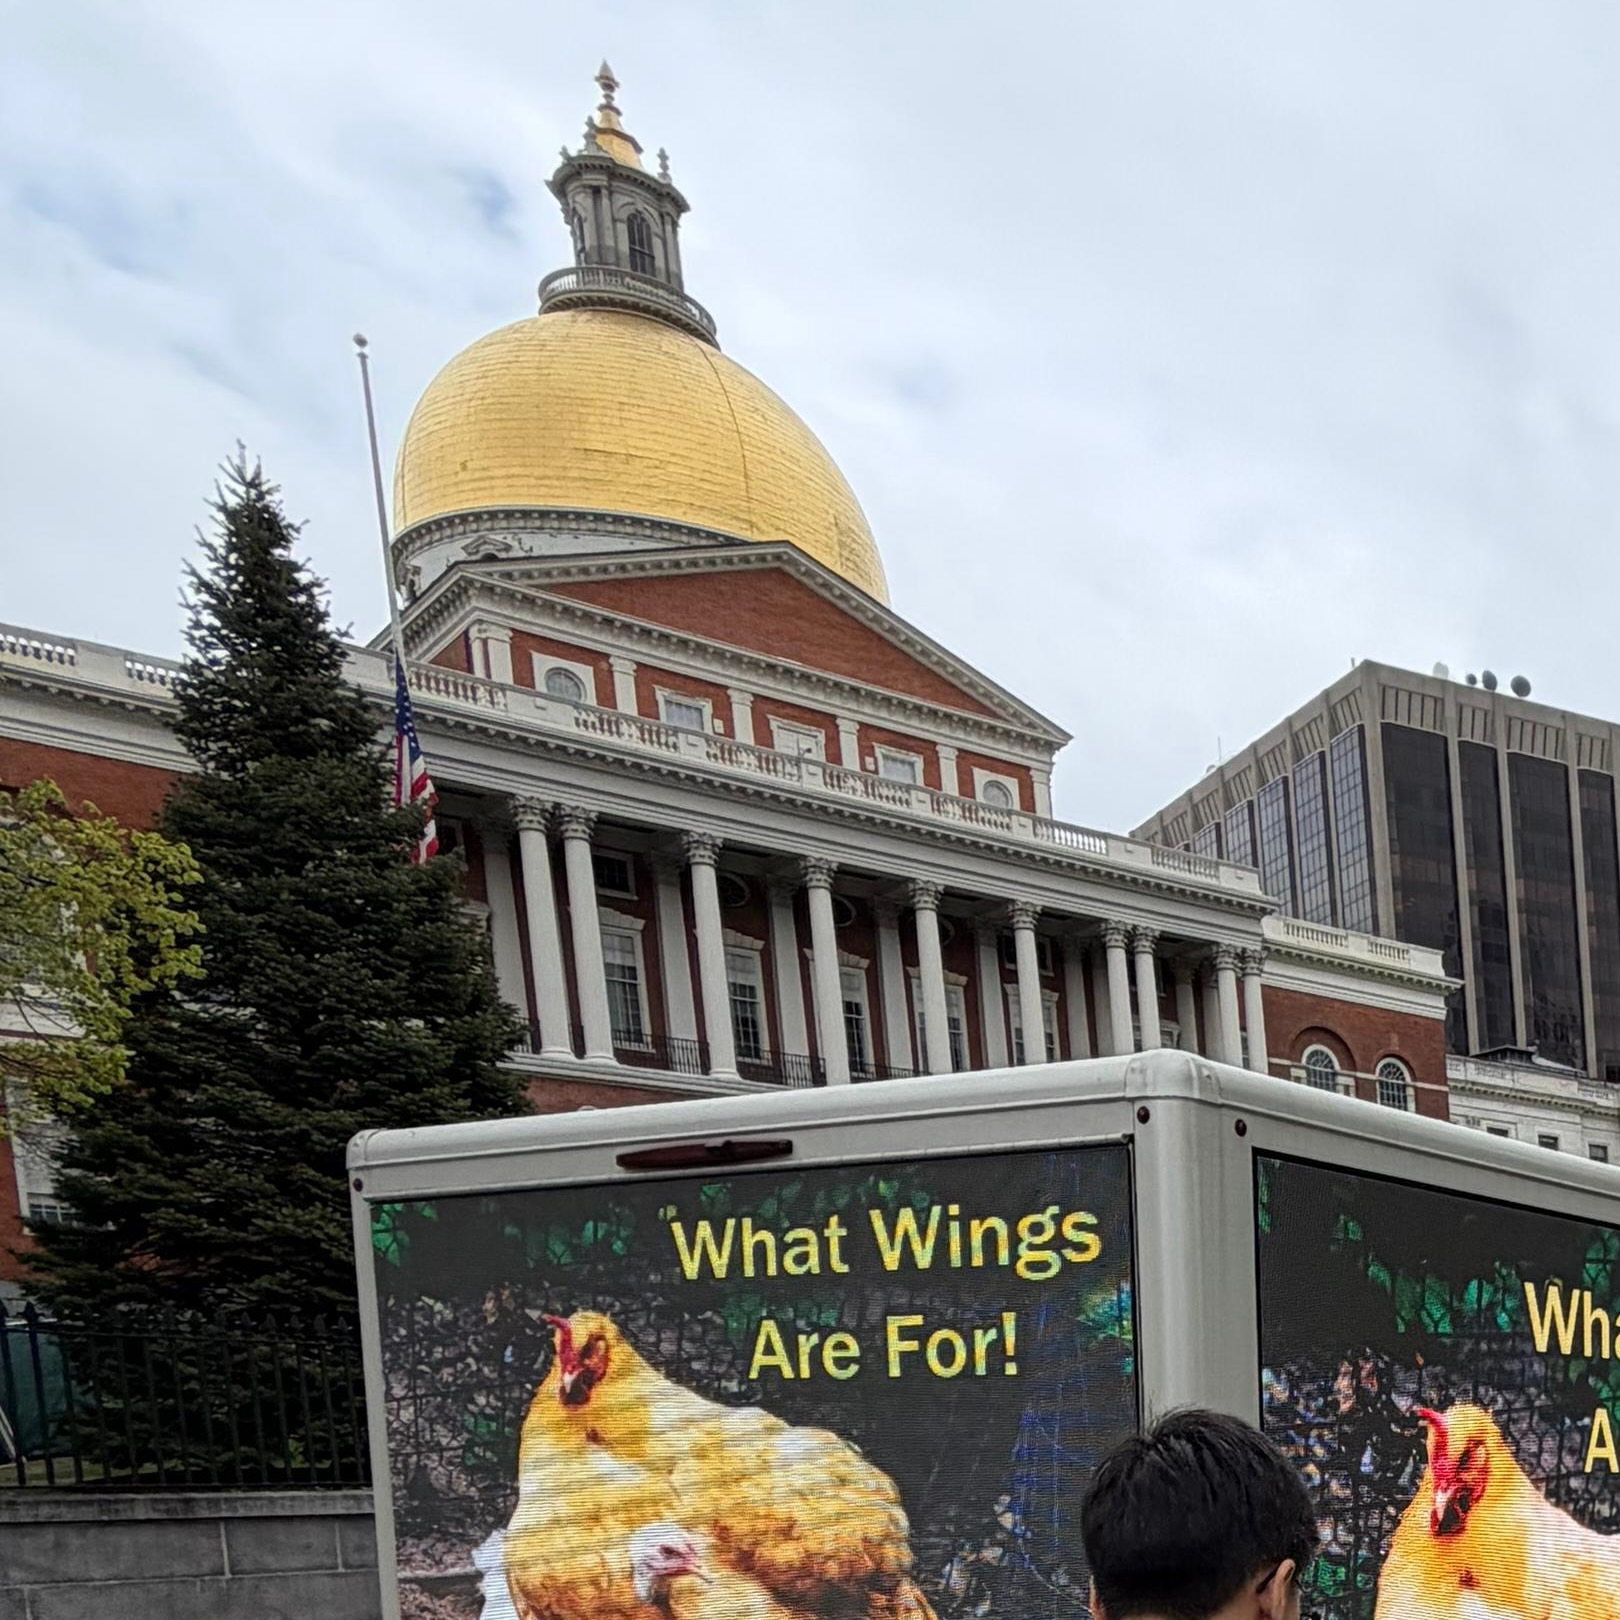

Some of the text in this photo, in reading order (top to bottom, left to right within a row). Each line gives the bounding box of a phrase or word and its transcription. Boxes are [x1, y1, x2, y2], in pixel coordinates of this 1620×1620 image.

[671, 1204, 1101, 1280] What Wings
[748, 1311, 1018, 1380] Are For!
